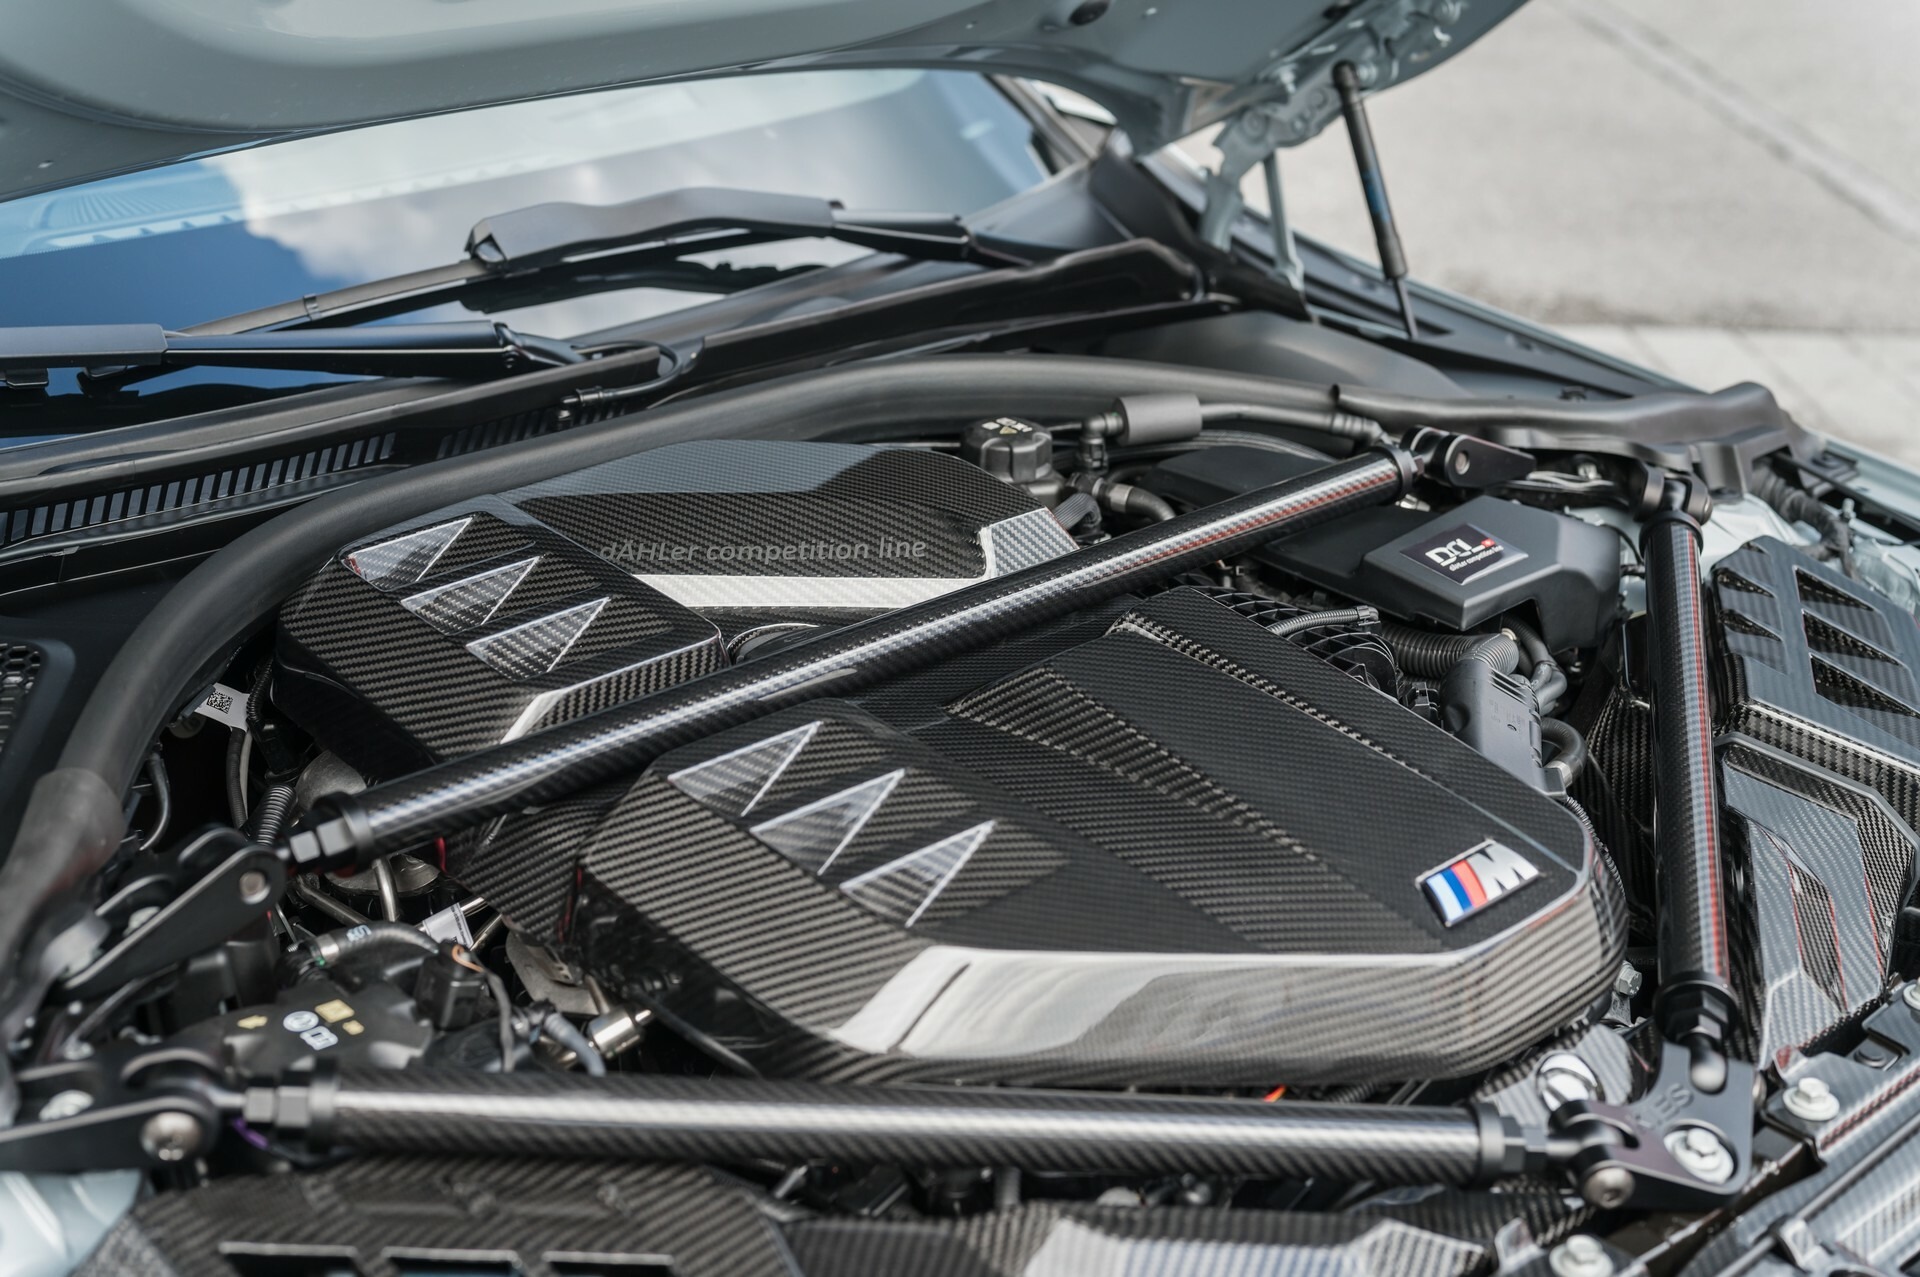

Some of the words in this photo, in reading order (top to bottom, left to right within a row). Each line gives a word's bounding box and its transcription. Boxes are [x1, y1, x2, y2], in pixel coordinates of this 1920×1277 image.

[600, 539, 701, 562] dÄHLer
[705, 539, 870, 565] competition
[878, 536, 928, 559] line
